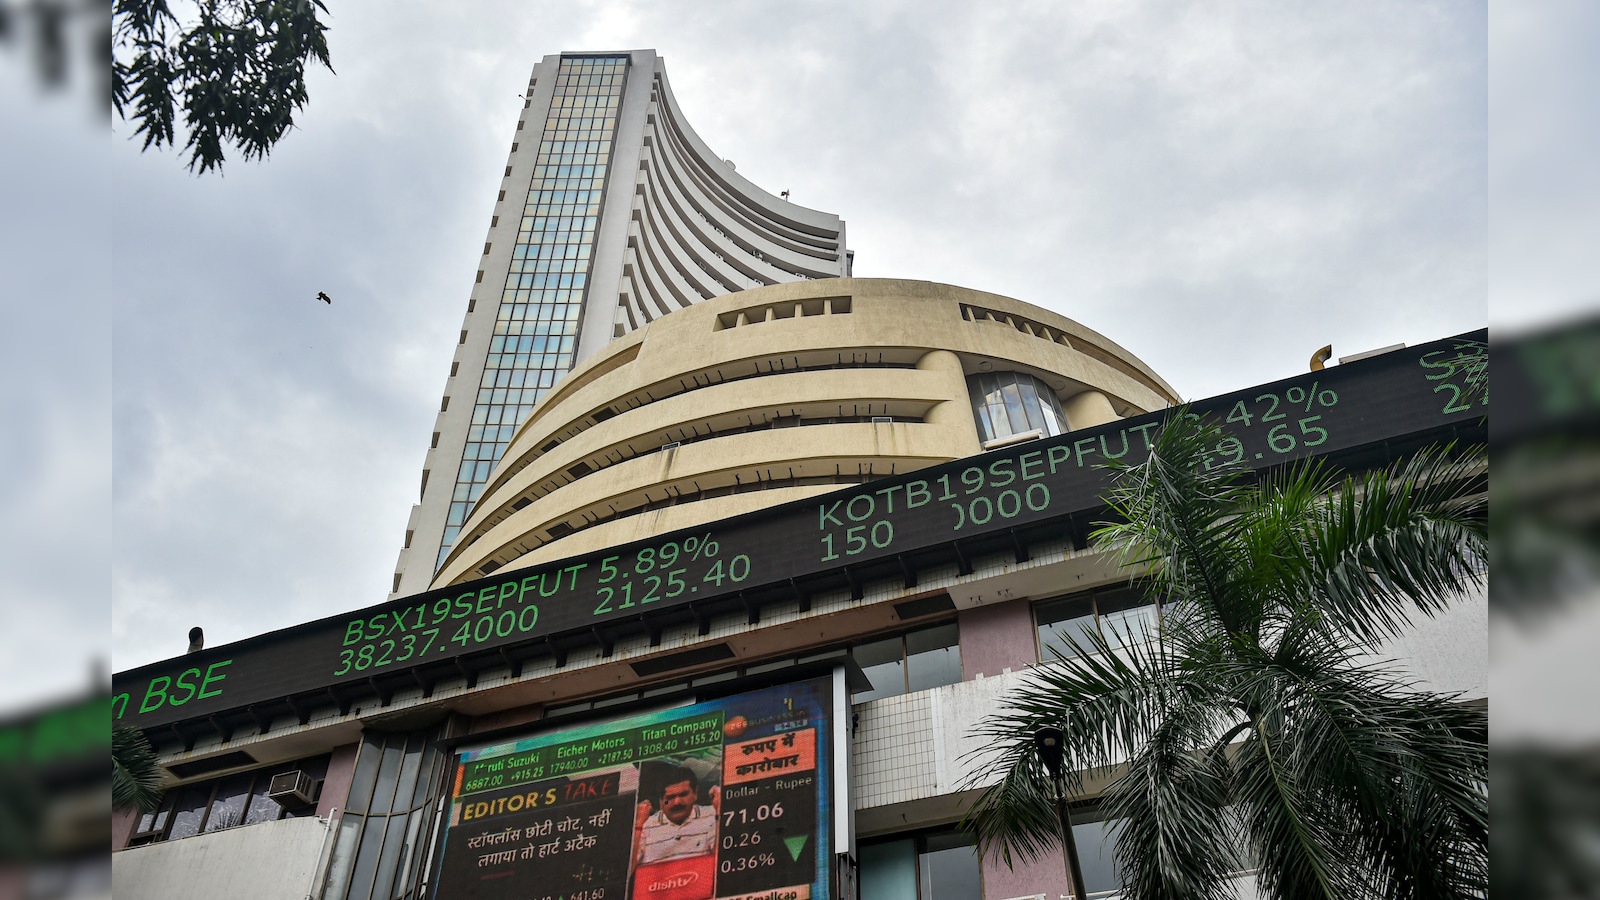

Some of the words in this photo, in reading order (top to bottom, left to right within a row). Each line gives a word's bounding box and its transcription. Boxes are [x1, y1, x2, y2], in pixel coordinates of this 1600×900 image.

[819, 421, 1160, 531] KOTB19SEPFUT
[819, 519, 895, 562] 150
[342, 563, 588, 647] BSX19SEPFUT
[597, 533, 720, 584] 5.89%
[334, 604, 539, 677] 38237.4000
[593, 554, 752, 616] 2125.40
[138, 659, 233, 714] BSE
[642, 728, 667, 741] Titan
[670, 718, 718, 734] Company
[781, 732, 796, 748] में
[465, 774, 504, 791] 6887.00
[550, 757, 589, 774] 17940.00
[638, 739, 678, 756] 1308.40
[684, 730, 721, 746] +155.20
[507, 751, 540, 769] Suzuki
[557, 744, 589, 759] Eicher
[591, 737, 626, 752] Motors
[735, 754, 800, 776] कारोबार
[463, 787, 558, 821] EDITOR'S
[565, 777, 614, 801] TAKE
[726, 784, 760, 799] Dollar
[775, 775, 812, 791] Rupee
[525, 819, 553, 839] छोटी
[588, 807, 613, 828] नहीं
[723, 801, 784, 828] 71.06
[477, 848, 517, 868] लगाया
[520, 842, 536, 860] तो
[538, 836, 561, 859] हार्ट
[564, 832, 598, 852] अटैक
[722, 830, 762, 850] 0.26
[721, 852, 776, 874] 0.36%
[648, 872, 699, 892] dishtv
